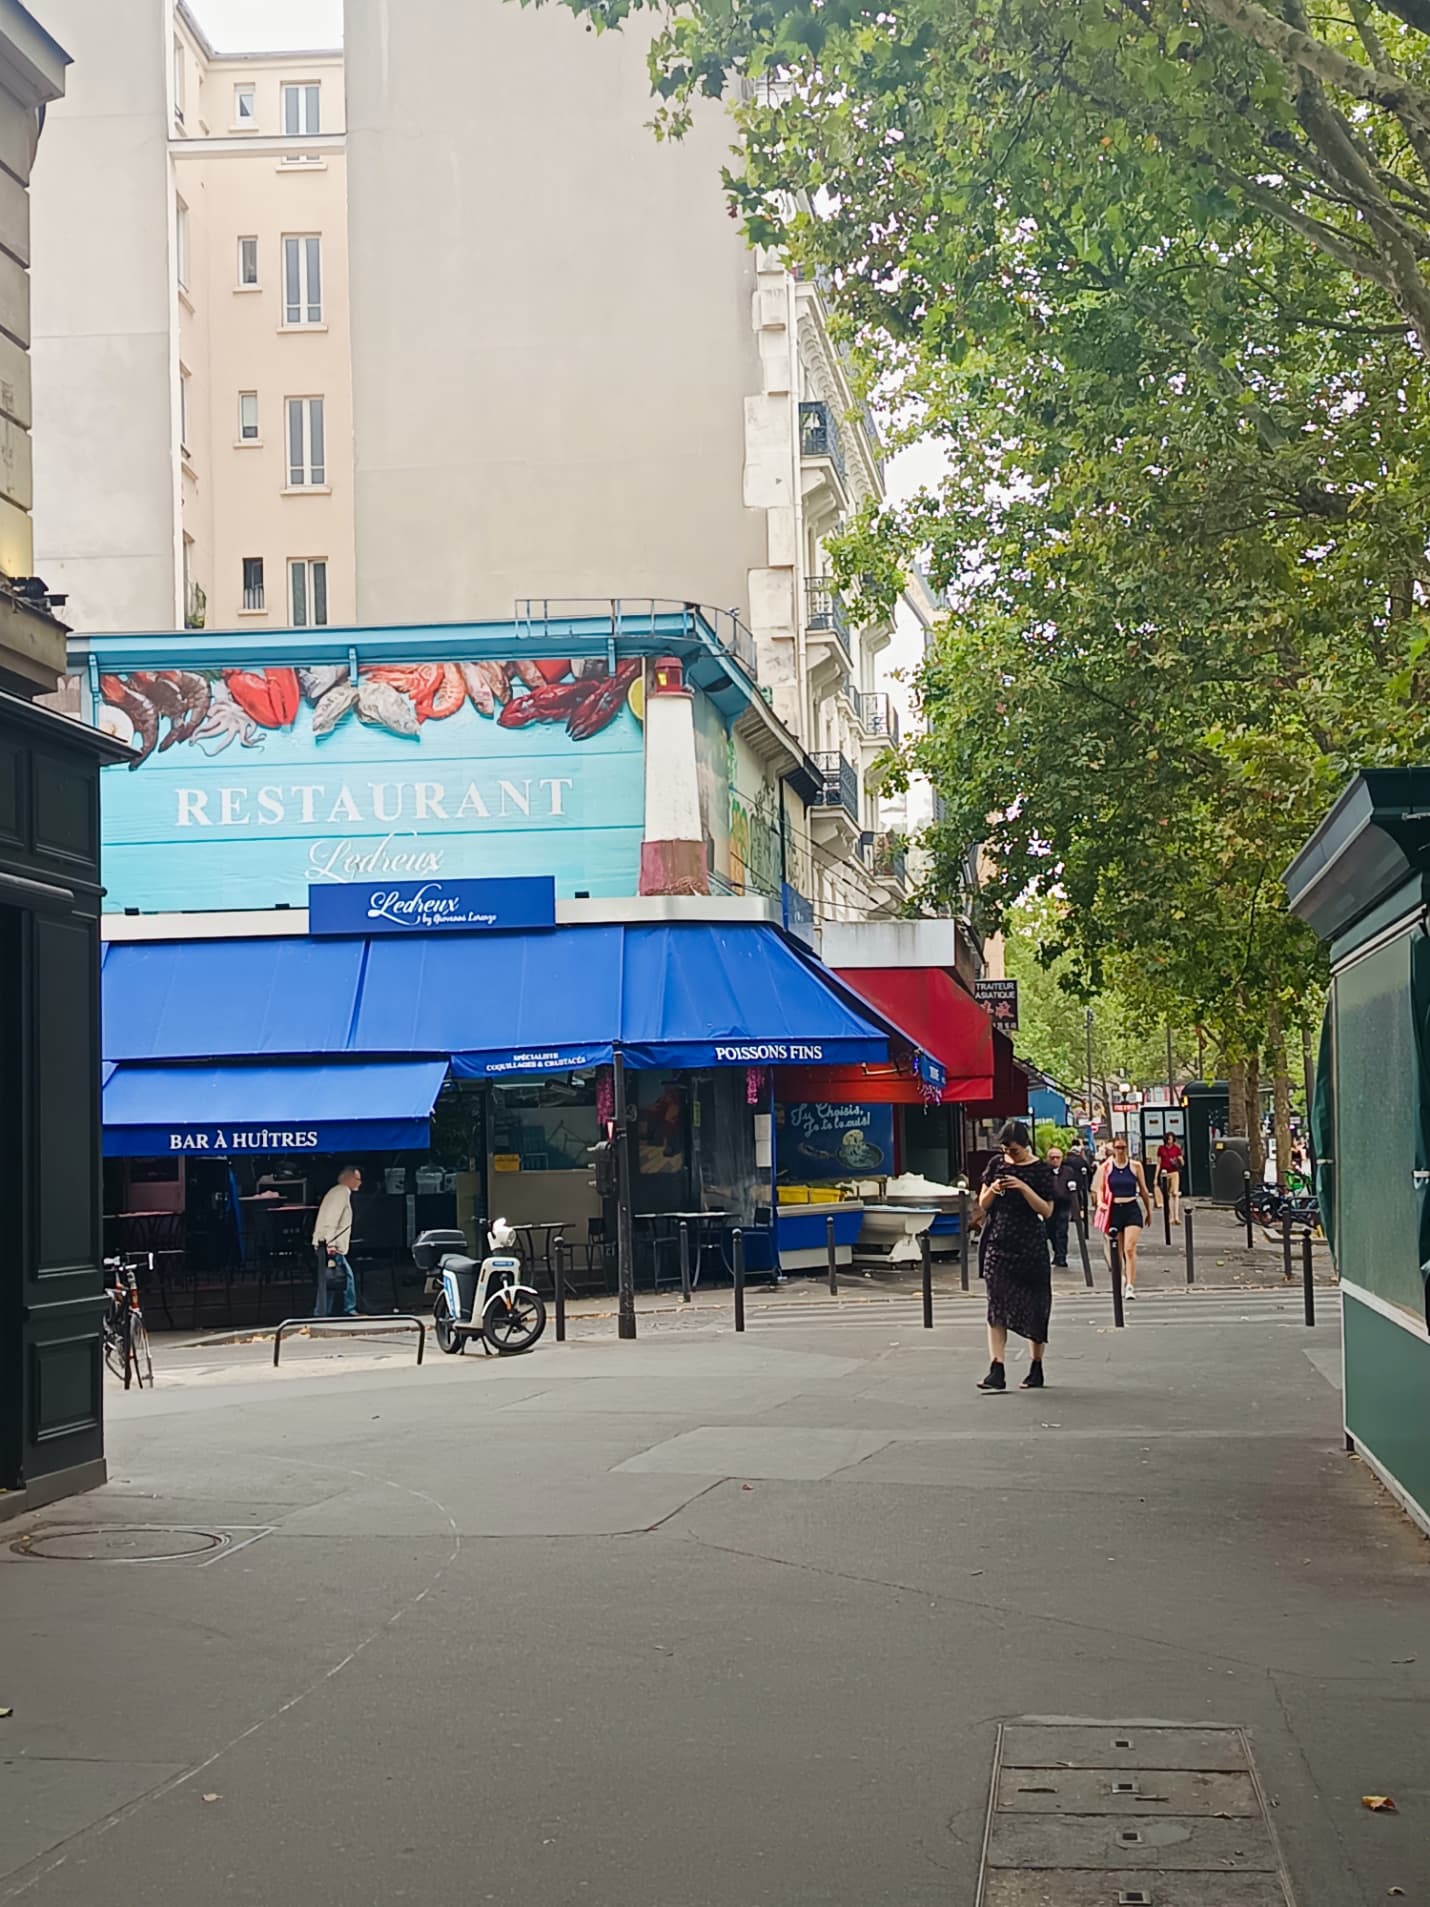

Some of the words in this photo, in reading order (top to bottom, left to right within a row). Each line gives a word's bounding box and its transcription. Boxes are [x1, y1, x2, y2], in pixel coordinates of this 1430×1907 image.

[175, 777, 574, 828] RESTAURANT
[304, 828, 445, 884] Ledreux
[367, 883, 460, 926] Ledreux
[974, 991, 1016, 999] ASIATIQUE
[975, 982, 1015, 990] TRAITEUR
[715, 1044, 788, 1061] POISSONS
[789, 1045, 823, 1060] FINS
[169, 1134, 209, 1150] BAR
[214, 1129, 228, 1149] À
[232, 1128, 318, 1148] HUÎTRES
